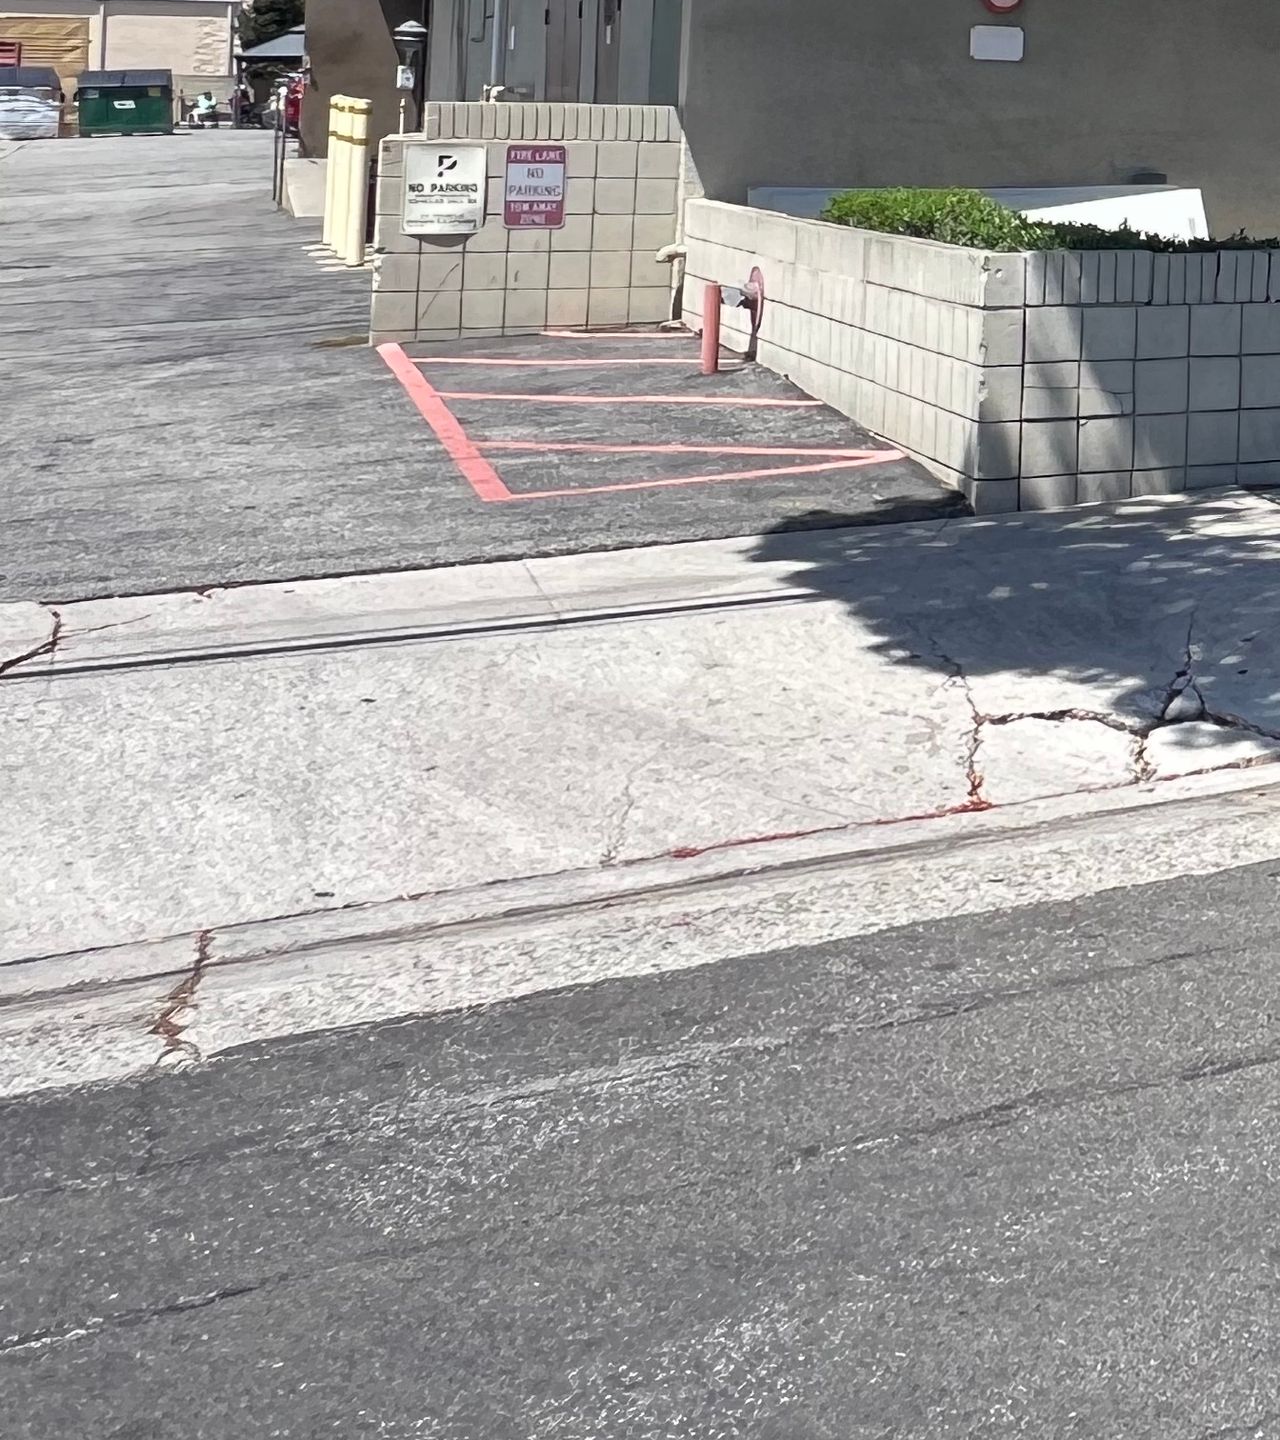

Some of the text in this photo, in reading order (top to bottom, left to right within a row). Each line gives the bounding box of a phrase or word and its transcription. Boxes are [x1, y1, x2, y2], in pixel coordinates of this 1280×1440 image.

[535, 150, 563, 161] LANE
[527, 168, 544, 179] NO
[408, 183, 478, 193] NO PARKING
[508, 185, 561, 197] PARKING
